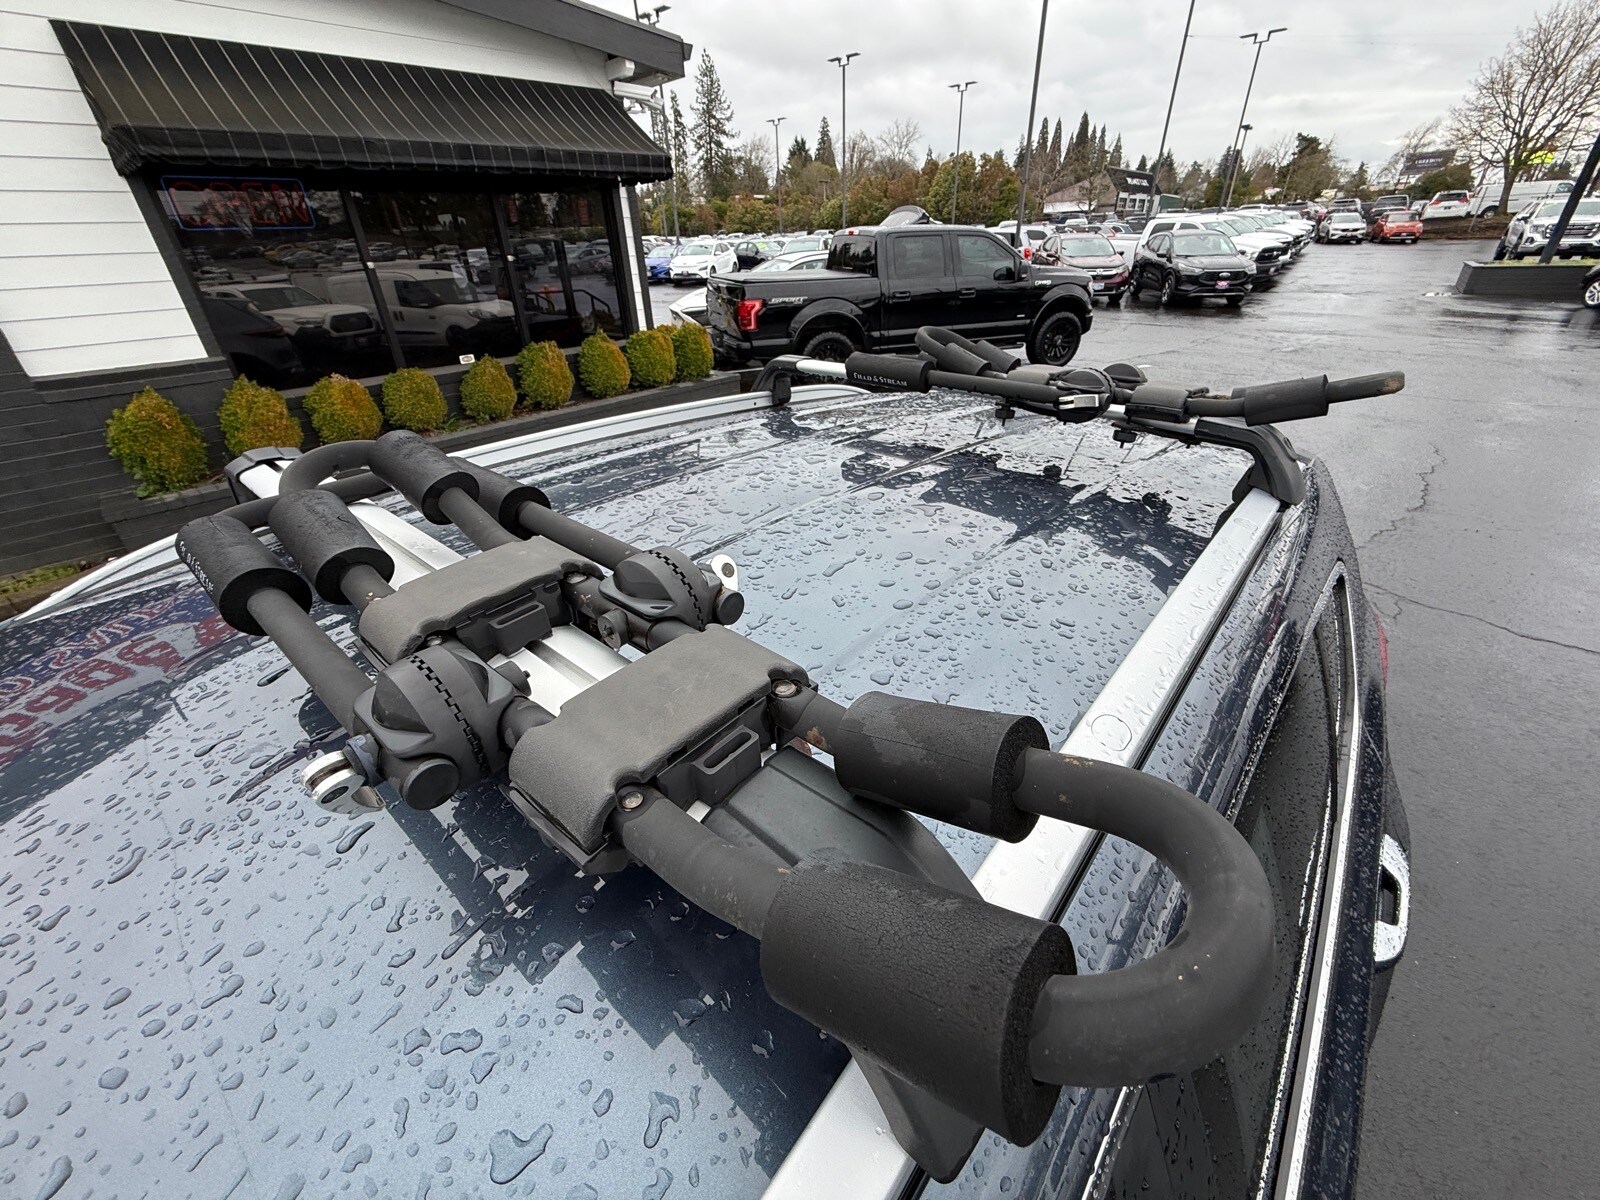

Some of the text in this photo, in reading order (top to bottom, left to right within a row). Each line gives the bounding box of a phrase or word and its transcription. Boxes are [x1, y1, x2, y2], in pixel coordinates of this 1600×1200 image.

[169, 182, 309, 225] OPEN
[769, 296, 808, 305] SPORT
[853, 372, 872, 381] FIELD
[879, 376, 907, 387] STREAM
